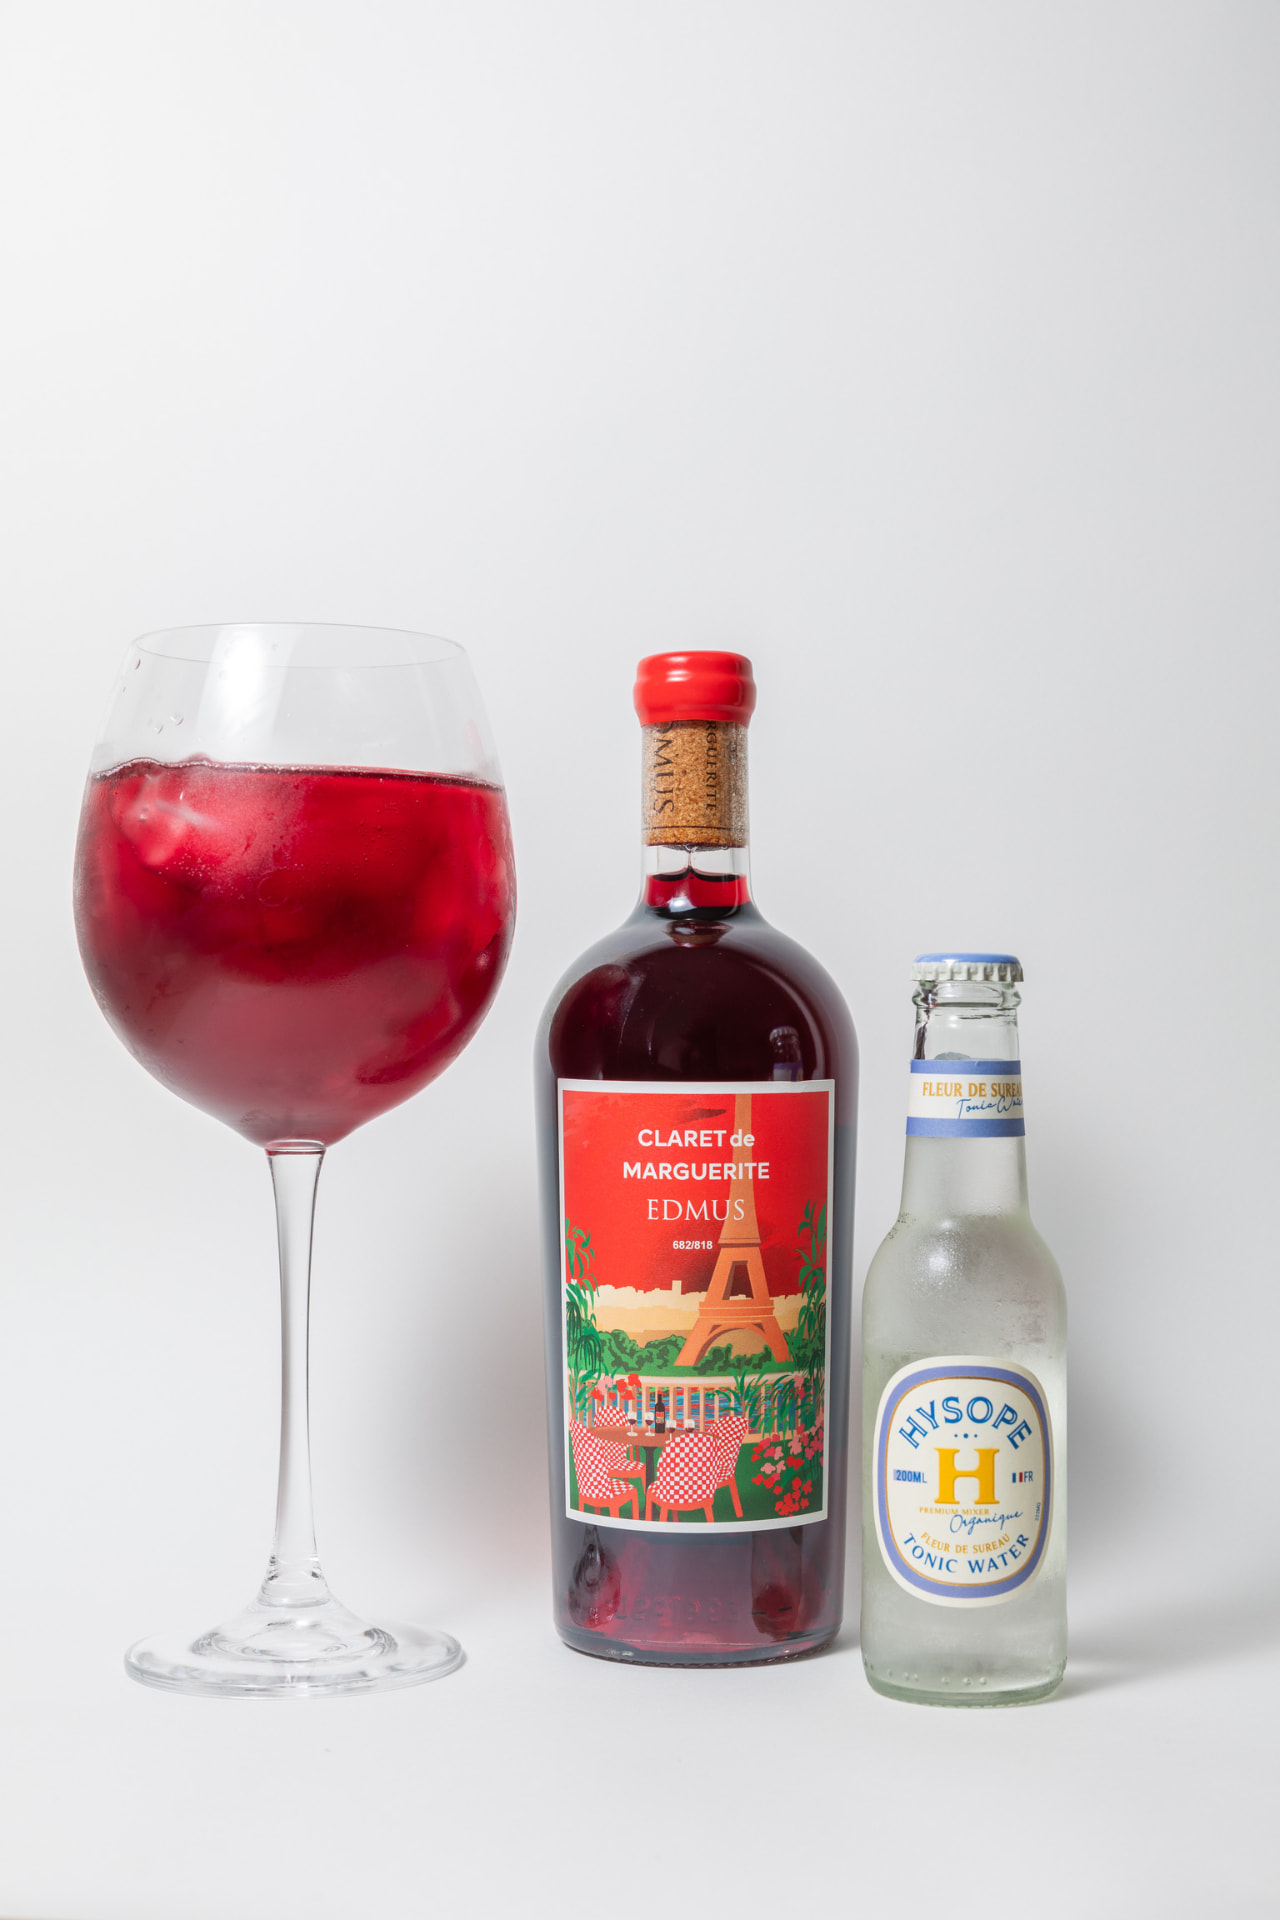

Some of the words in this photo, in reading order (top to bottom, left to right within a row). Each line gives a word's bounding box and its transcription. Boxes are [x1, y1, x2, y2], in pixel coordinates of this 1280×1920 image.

[922, 1081, 963, 1098] FLEUR
[968, 1082, 988, 1098] DE
[955, 1098, 997, 1120] Tonic
[637, 1129, 727, 1148] CLARET
[729, 1128, 756, 1148] de
[623, 1162, 770, 1180] MARGUERITE
[647, 1198, 746, 1222] EDMUS
[672, 1240, 713, 1251] 682/818
[898, 1396, 1032, 1449] HYSOPE
[895, 1469, 928, 1484] 200ML
[934, 1448, 1000, 1505] H
[1023, 1471, 1034, 1484] FR
[918, 1506, 960, 1516] PREMIUM
[961, 1508, 991, 1517] MIXER
[949, 1511, 1023, 1536] Organique
[903, 1533, 958, 1574] TONIC
[967, 1533, 1029, 1574] WATER
[920, 1531, 951, 1554] FLEUR
[955, 1544, 969, 1555] DE
[972, 1533, 1011, 1555] SUREAU
